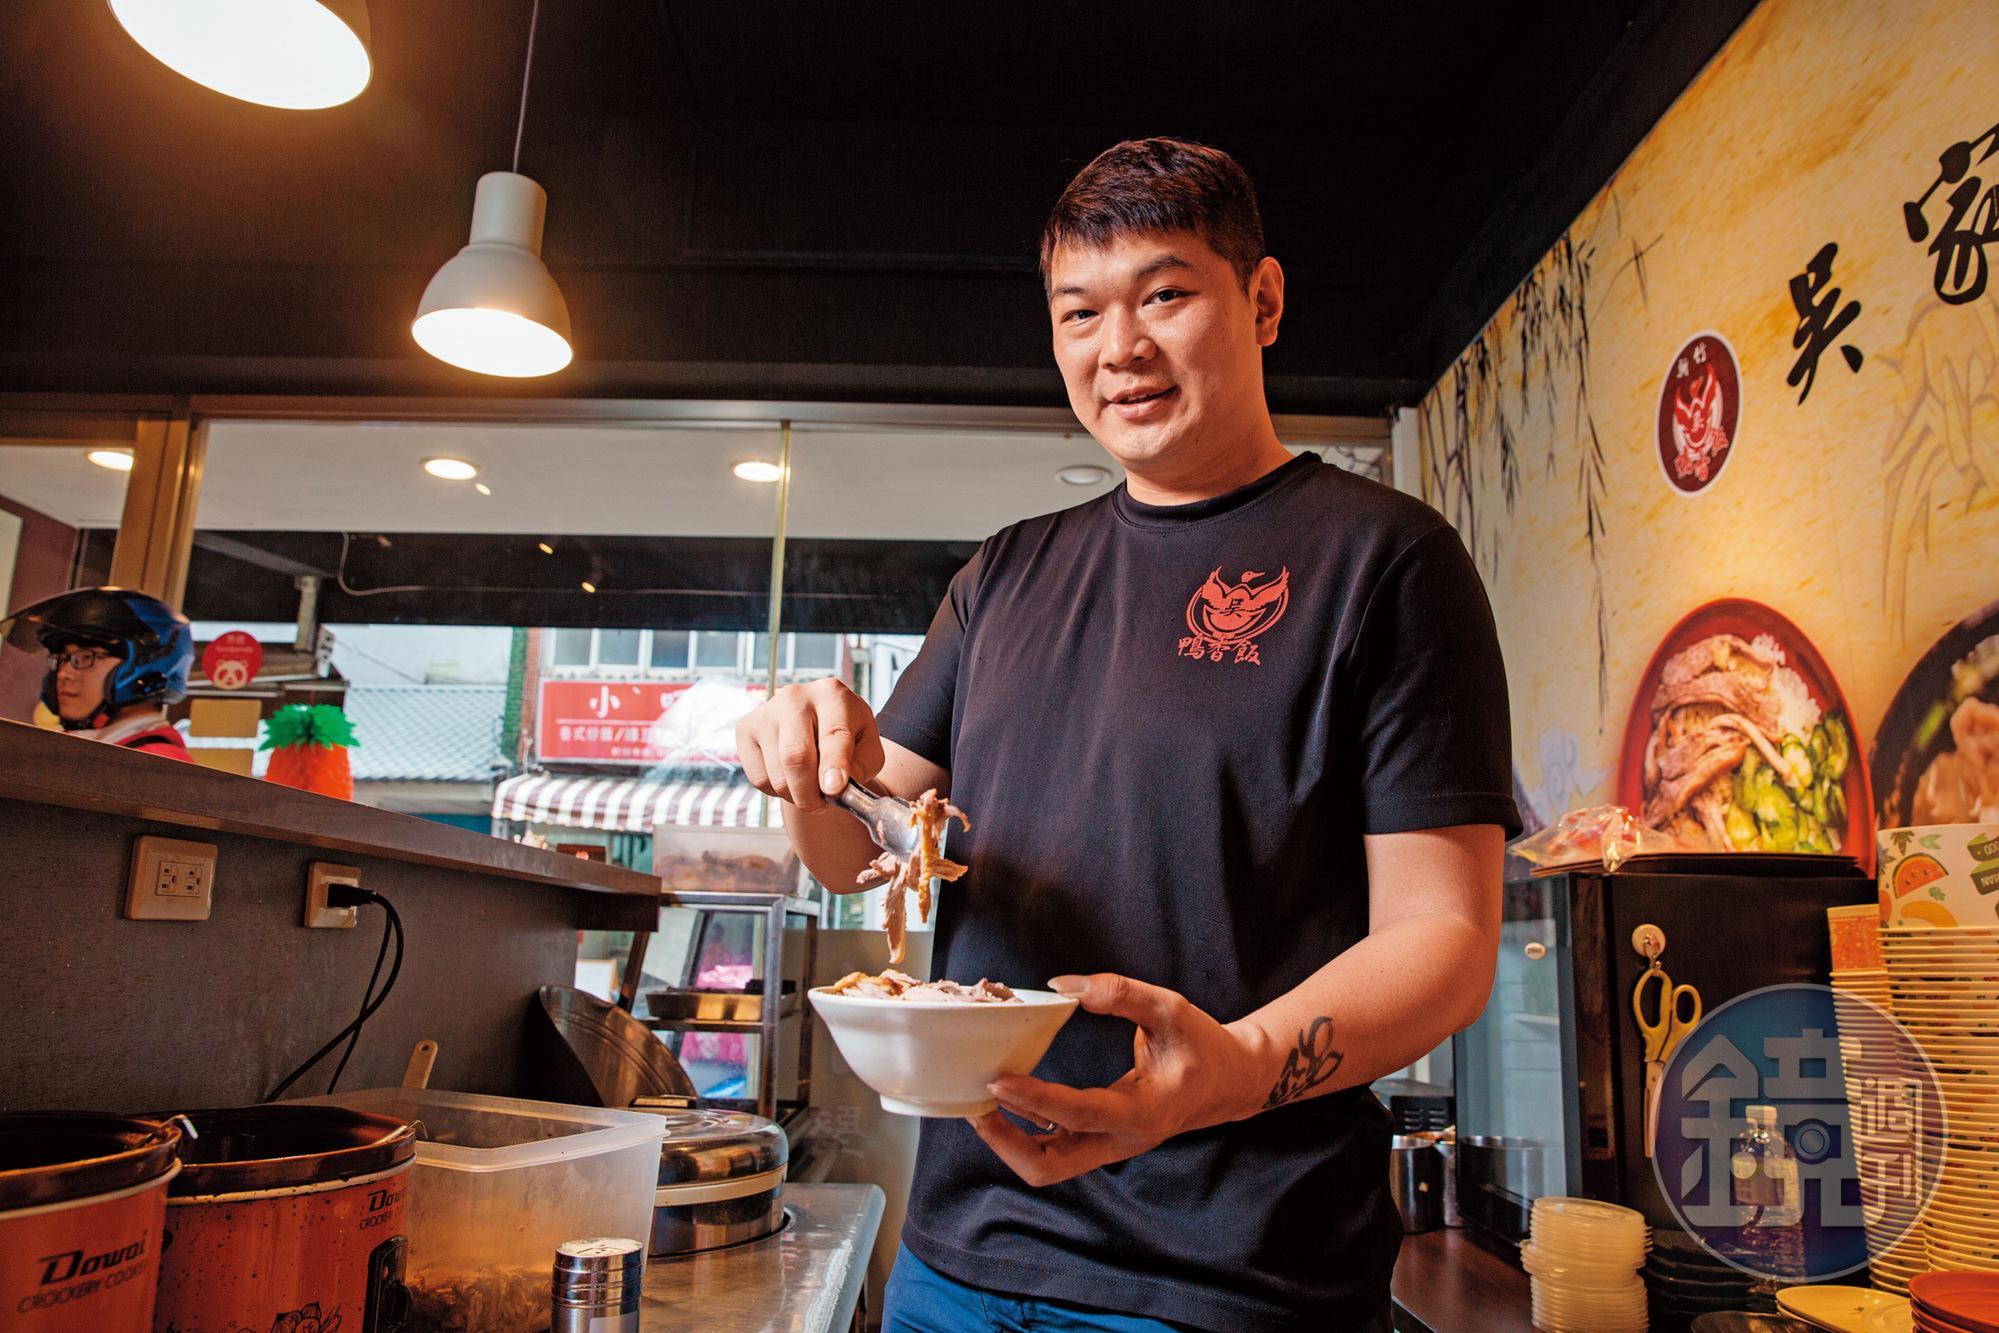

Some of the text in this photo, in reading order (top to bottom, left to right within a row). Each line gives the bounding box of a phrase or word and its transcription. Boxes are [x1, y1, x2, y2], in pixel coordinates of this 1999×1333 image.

[1178, 632, 1262, 666] 鴨香飯
[37, 1228, 148, 1286] Dowai
